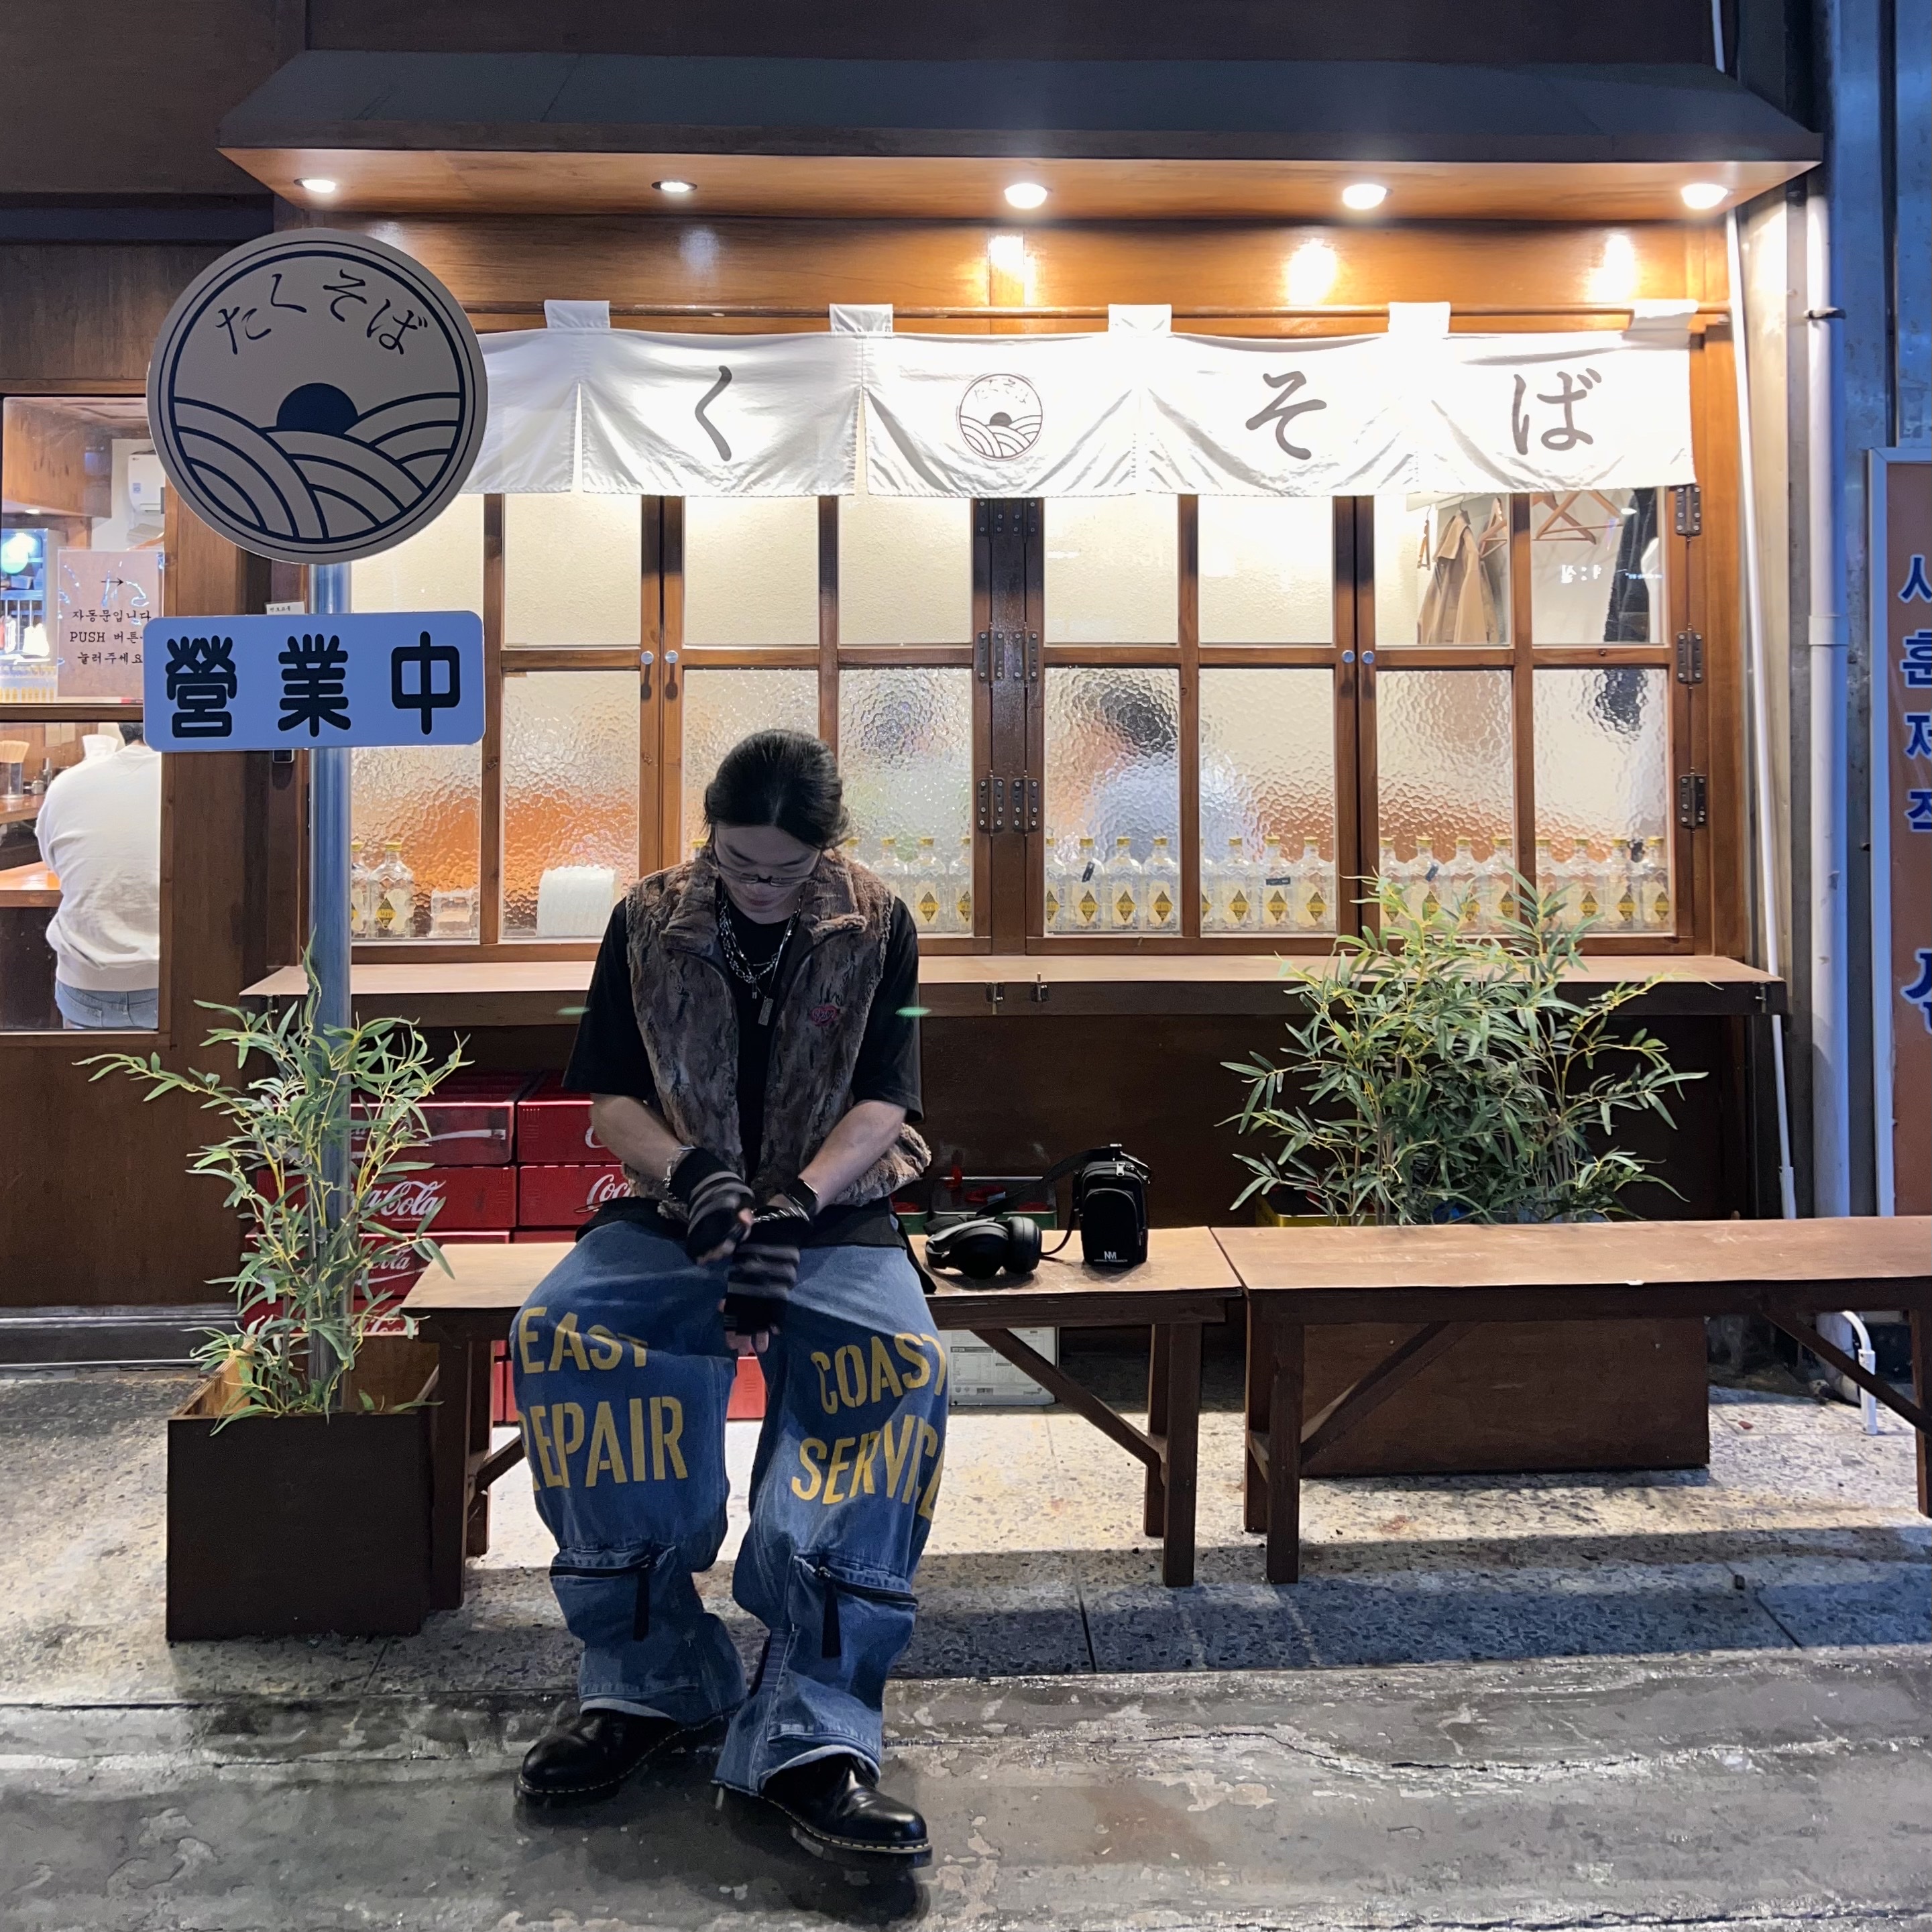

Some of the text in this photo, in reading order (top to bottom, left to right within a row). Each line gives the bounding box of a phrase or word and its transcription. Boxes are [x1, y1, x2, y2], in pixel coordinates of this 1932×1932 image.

[217, 269, 429, 355] たくそば
[72, 609, 152, 623] 자동문입니다
[69, 631, 144, 644] PUSH 버튼
[77, 651, 144, 665] 눌러주세요
[165, 631, 461, 738] 營業中
[518, 1306, 648, 1374] EAST
